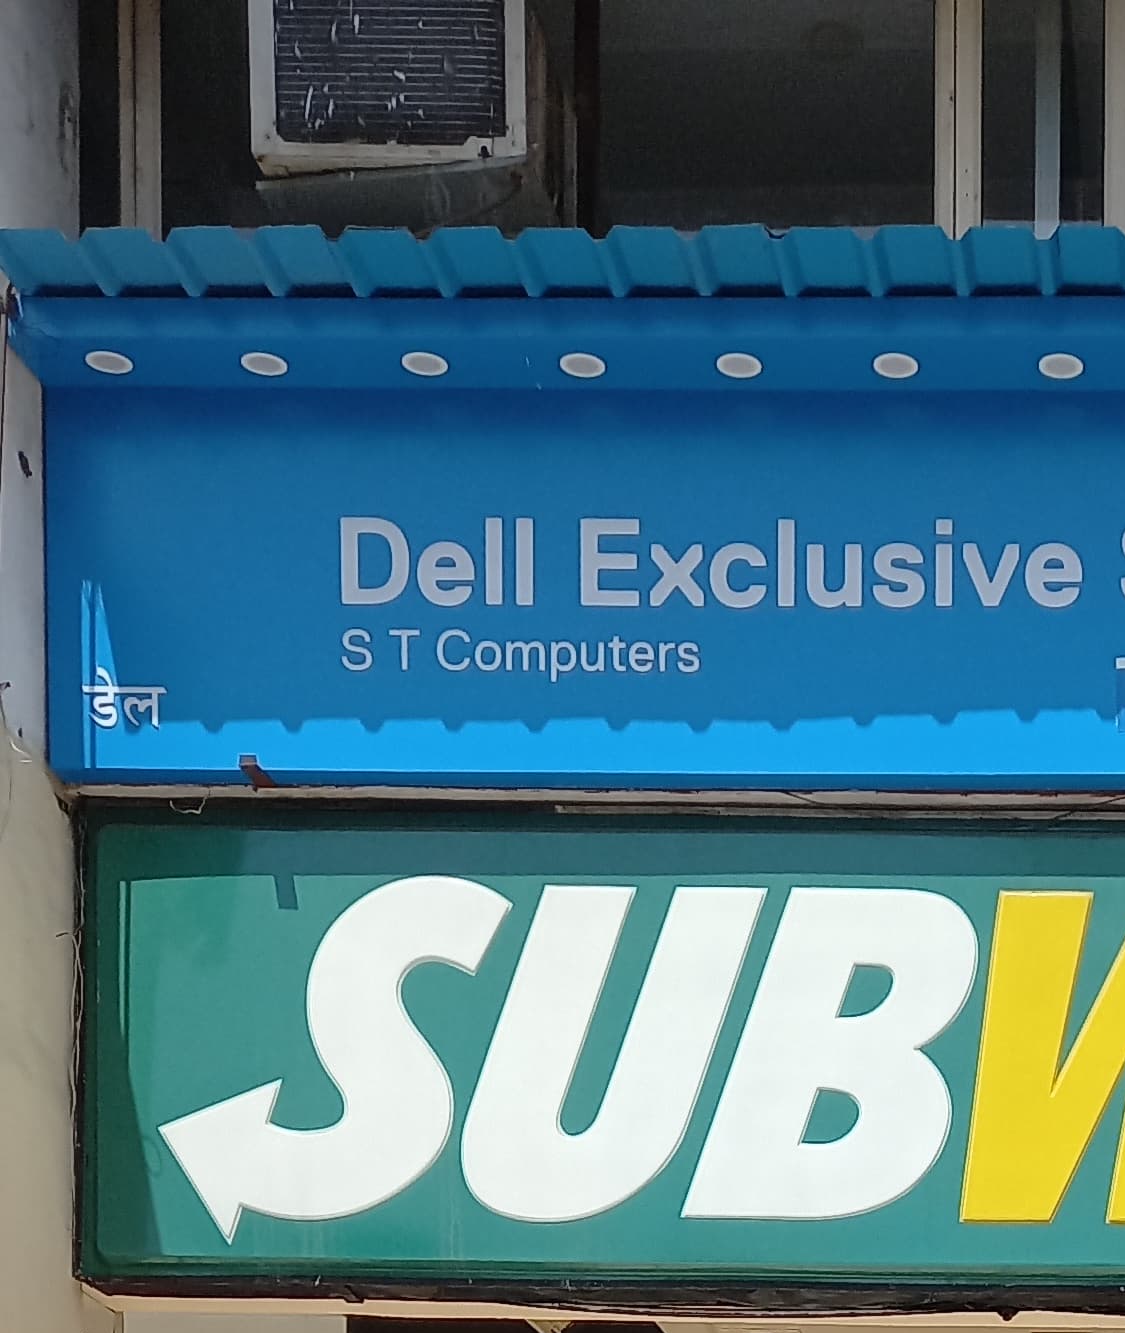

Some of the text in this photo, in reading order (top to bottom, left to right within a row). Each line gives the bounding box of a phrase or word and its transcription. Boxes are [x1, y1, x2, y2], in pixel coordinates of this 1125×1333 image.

[339, 516, 535, 607] Dell
[579, 516, 1085, 611] Exclusive
[341, 628, 702, 683] S T Computers
[82, 666, 168, 729] डेल
